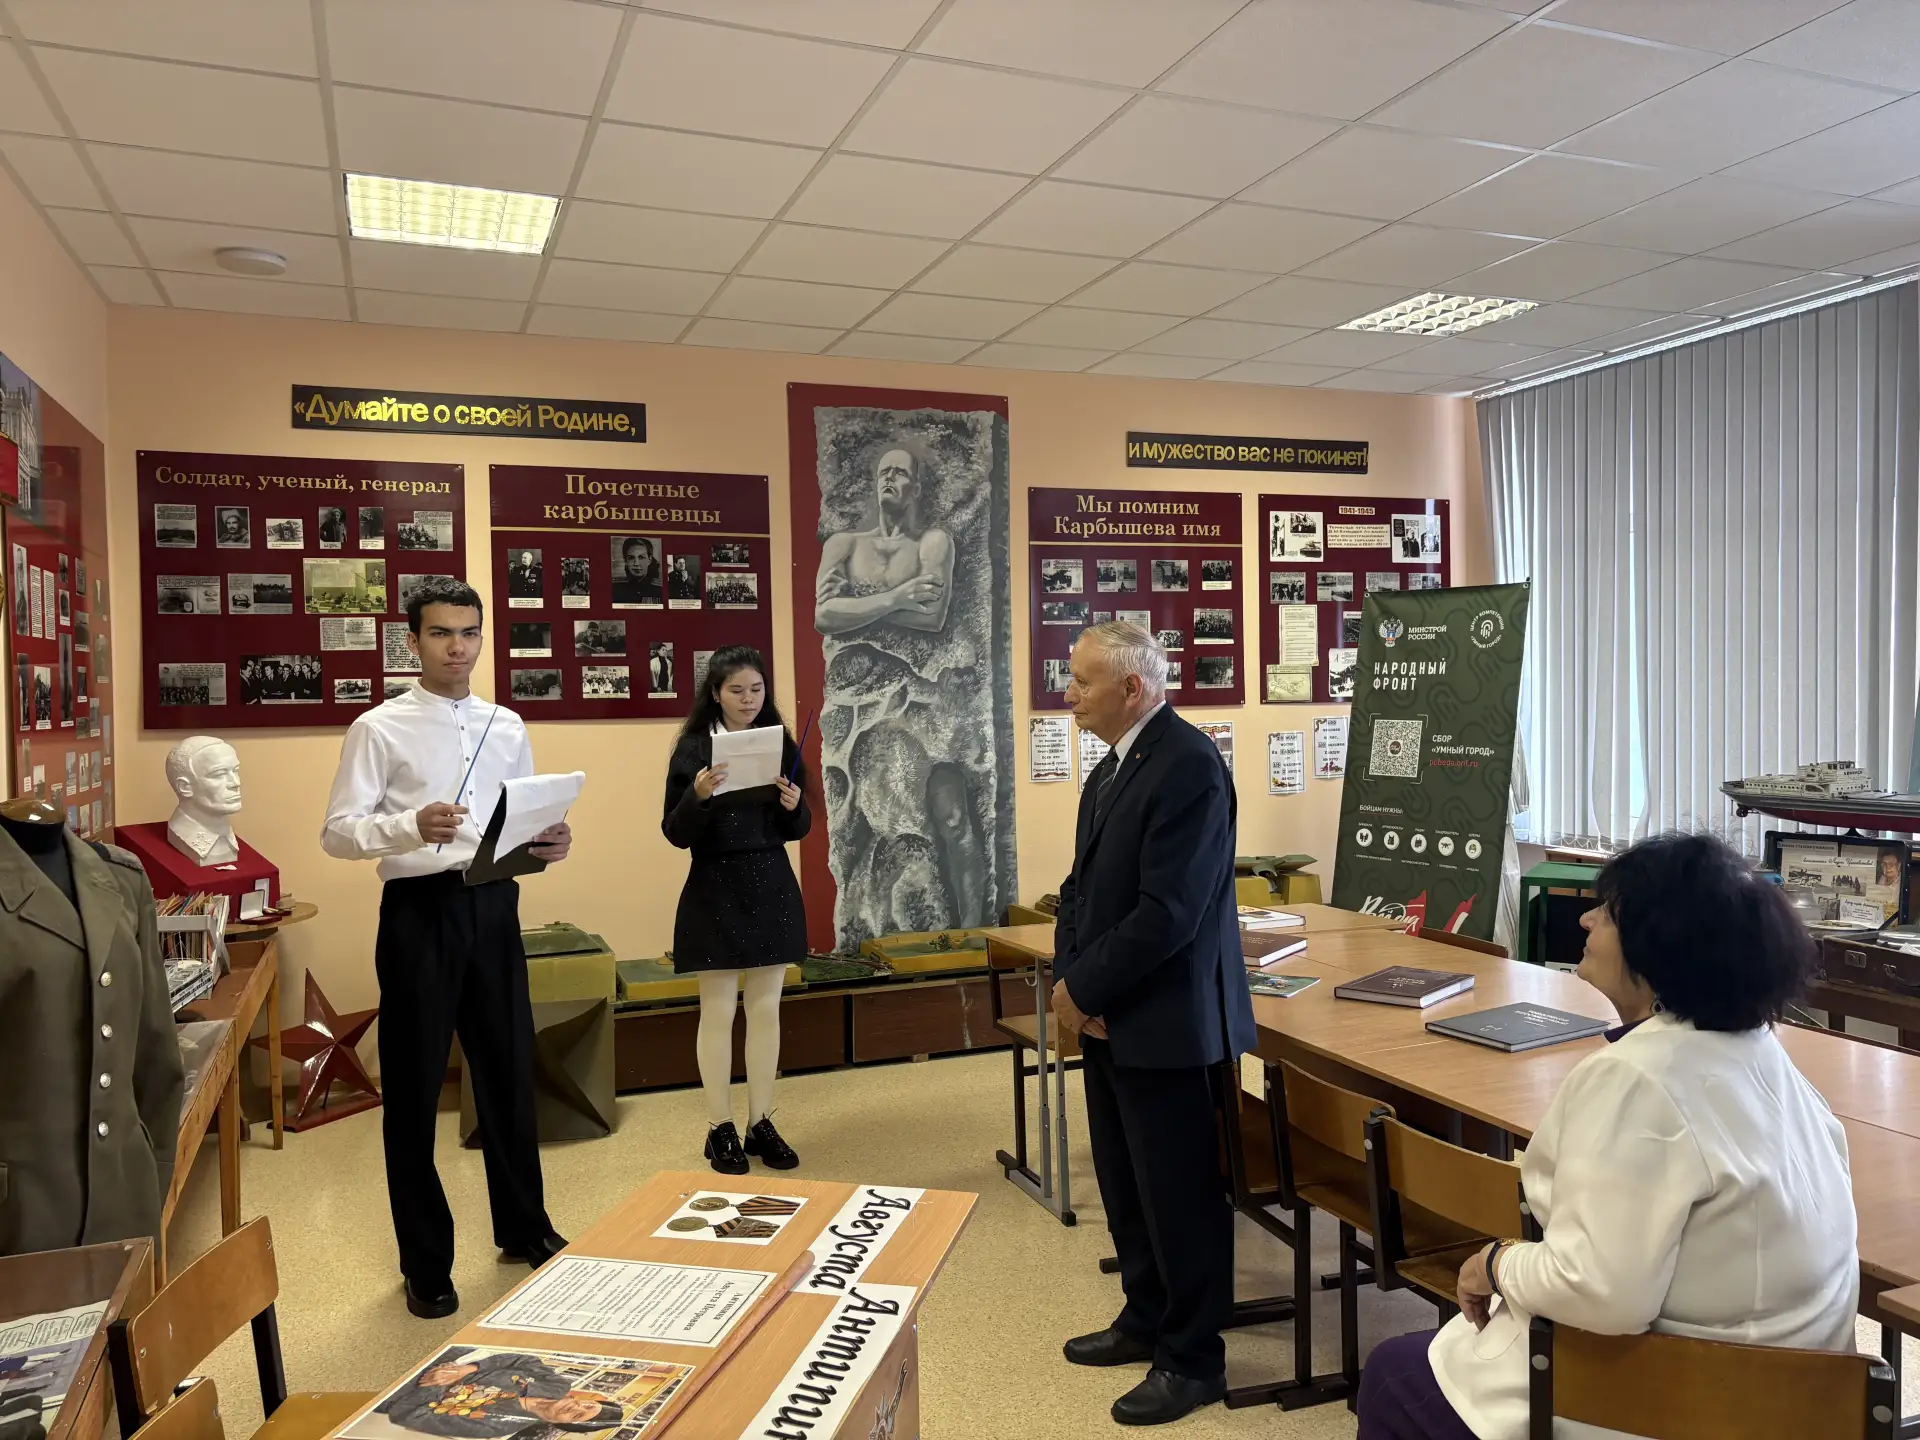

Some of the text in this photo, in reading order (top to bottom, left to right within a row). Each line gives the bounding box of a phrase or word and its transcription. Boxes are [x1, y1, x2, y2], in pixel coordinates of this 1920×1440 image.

[294, 394, 637, 436] «Думайте о своей Родине,
[1128, 442, 1140, 458] и
[1143, 441, 1236, 463] мужество
[1238, 446, 1271, 463] вас
[1273, 447, 1295, 464] не
[155, 466, 451, 496] Солдат, ученый, генерал
[565, 474, 700, 499] Почетные
[544, 500, 722, 526] карбышевцы
[1076, 495, 1200, 515] Мы помним
[1340, 507, 1374, 515] 1941-1945
[1054, 516, 1221, 539] Карбышева имя
[1408, 625, 1447, 634] МИНСТРОЙ
[1374, 658, 1446, 676] НАРОДНЫЙ
[1373, 677, 1417, 691] ФРОНТ
[1432, 735, 1452, 743] СБОР
[1431, 745, 1495, 757] «УМНЫЙ ГОРОД»
[809, 1188, 911, 1290] Августа
